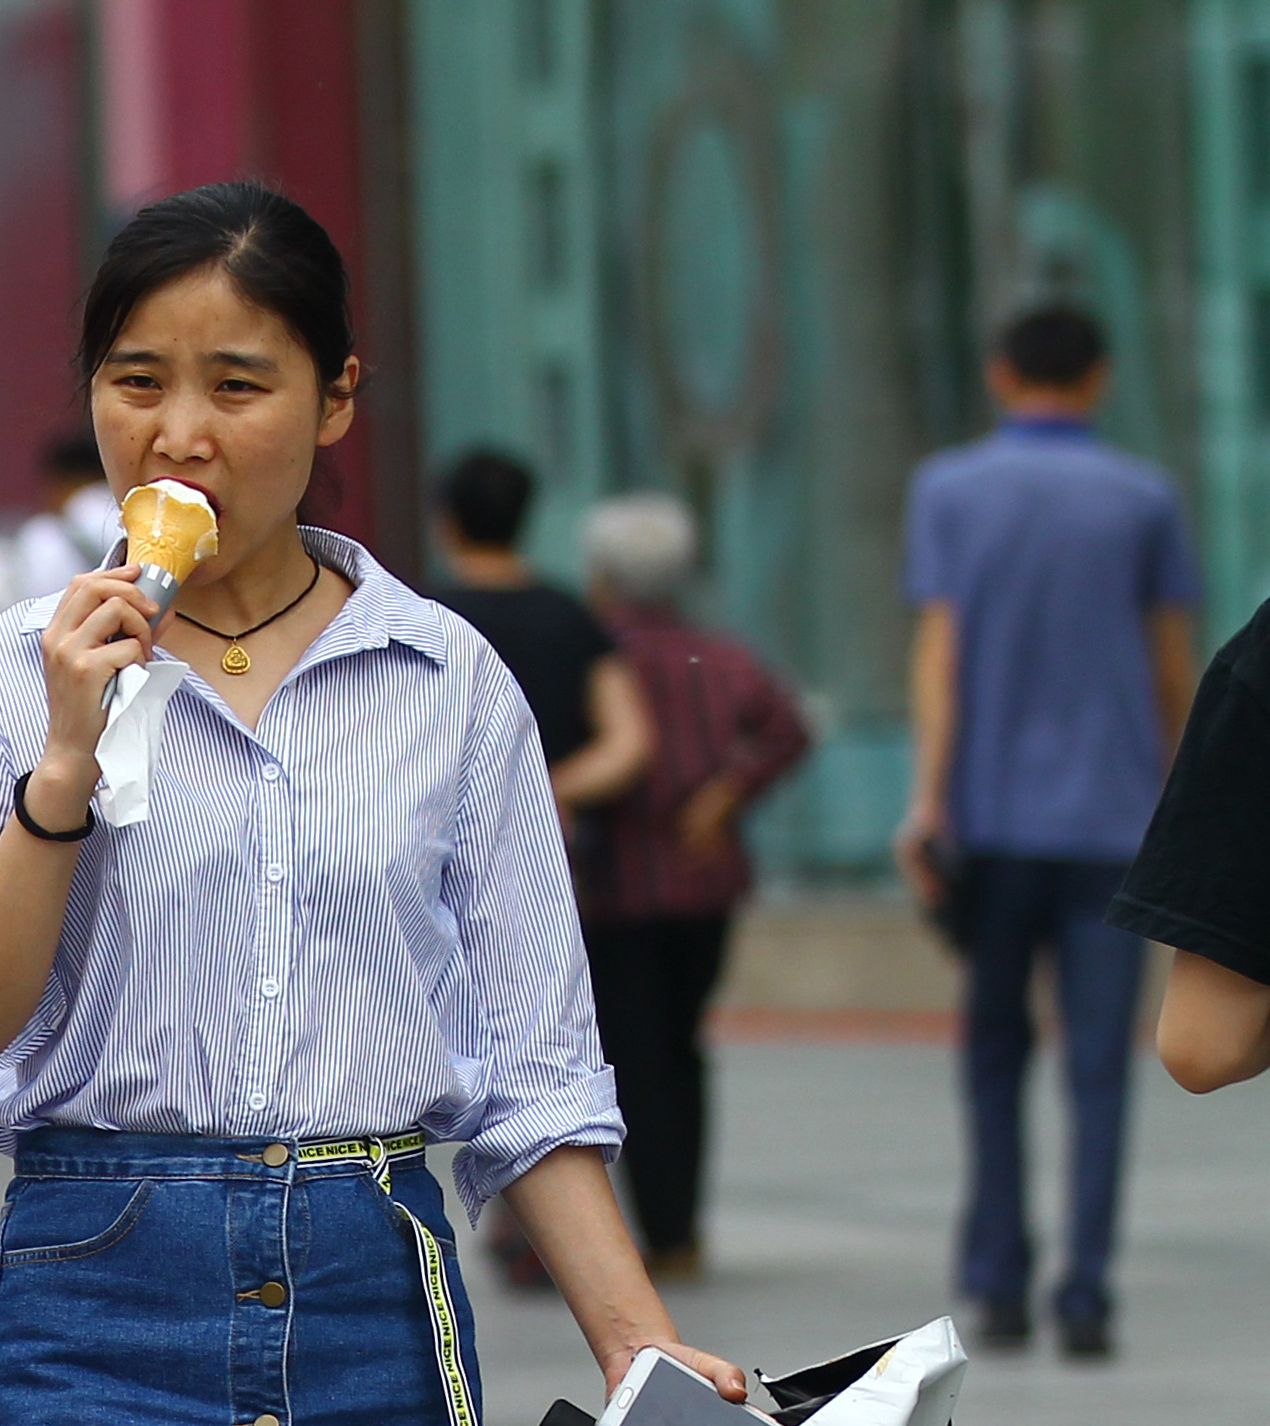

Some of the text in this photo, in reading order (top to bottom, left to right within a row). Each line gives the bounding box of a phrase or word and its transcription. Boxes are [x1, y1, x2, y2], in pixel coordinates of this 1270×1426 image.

[326, 1142, 358, 1155] NICE
[429, 1266, 440, 1300] NICE
[436, 1301, 450, 1336] NICE
[443, 1338, 456, 1372] NICE
[450, 1374, 463, 1409] NICE
